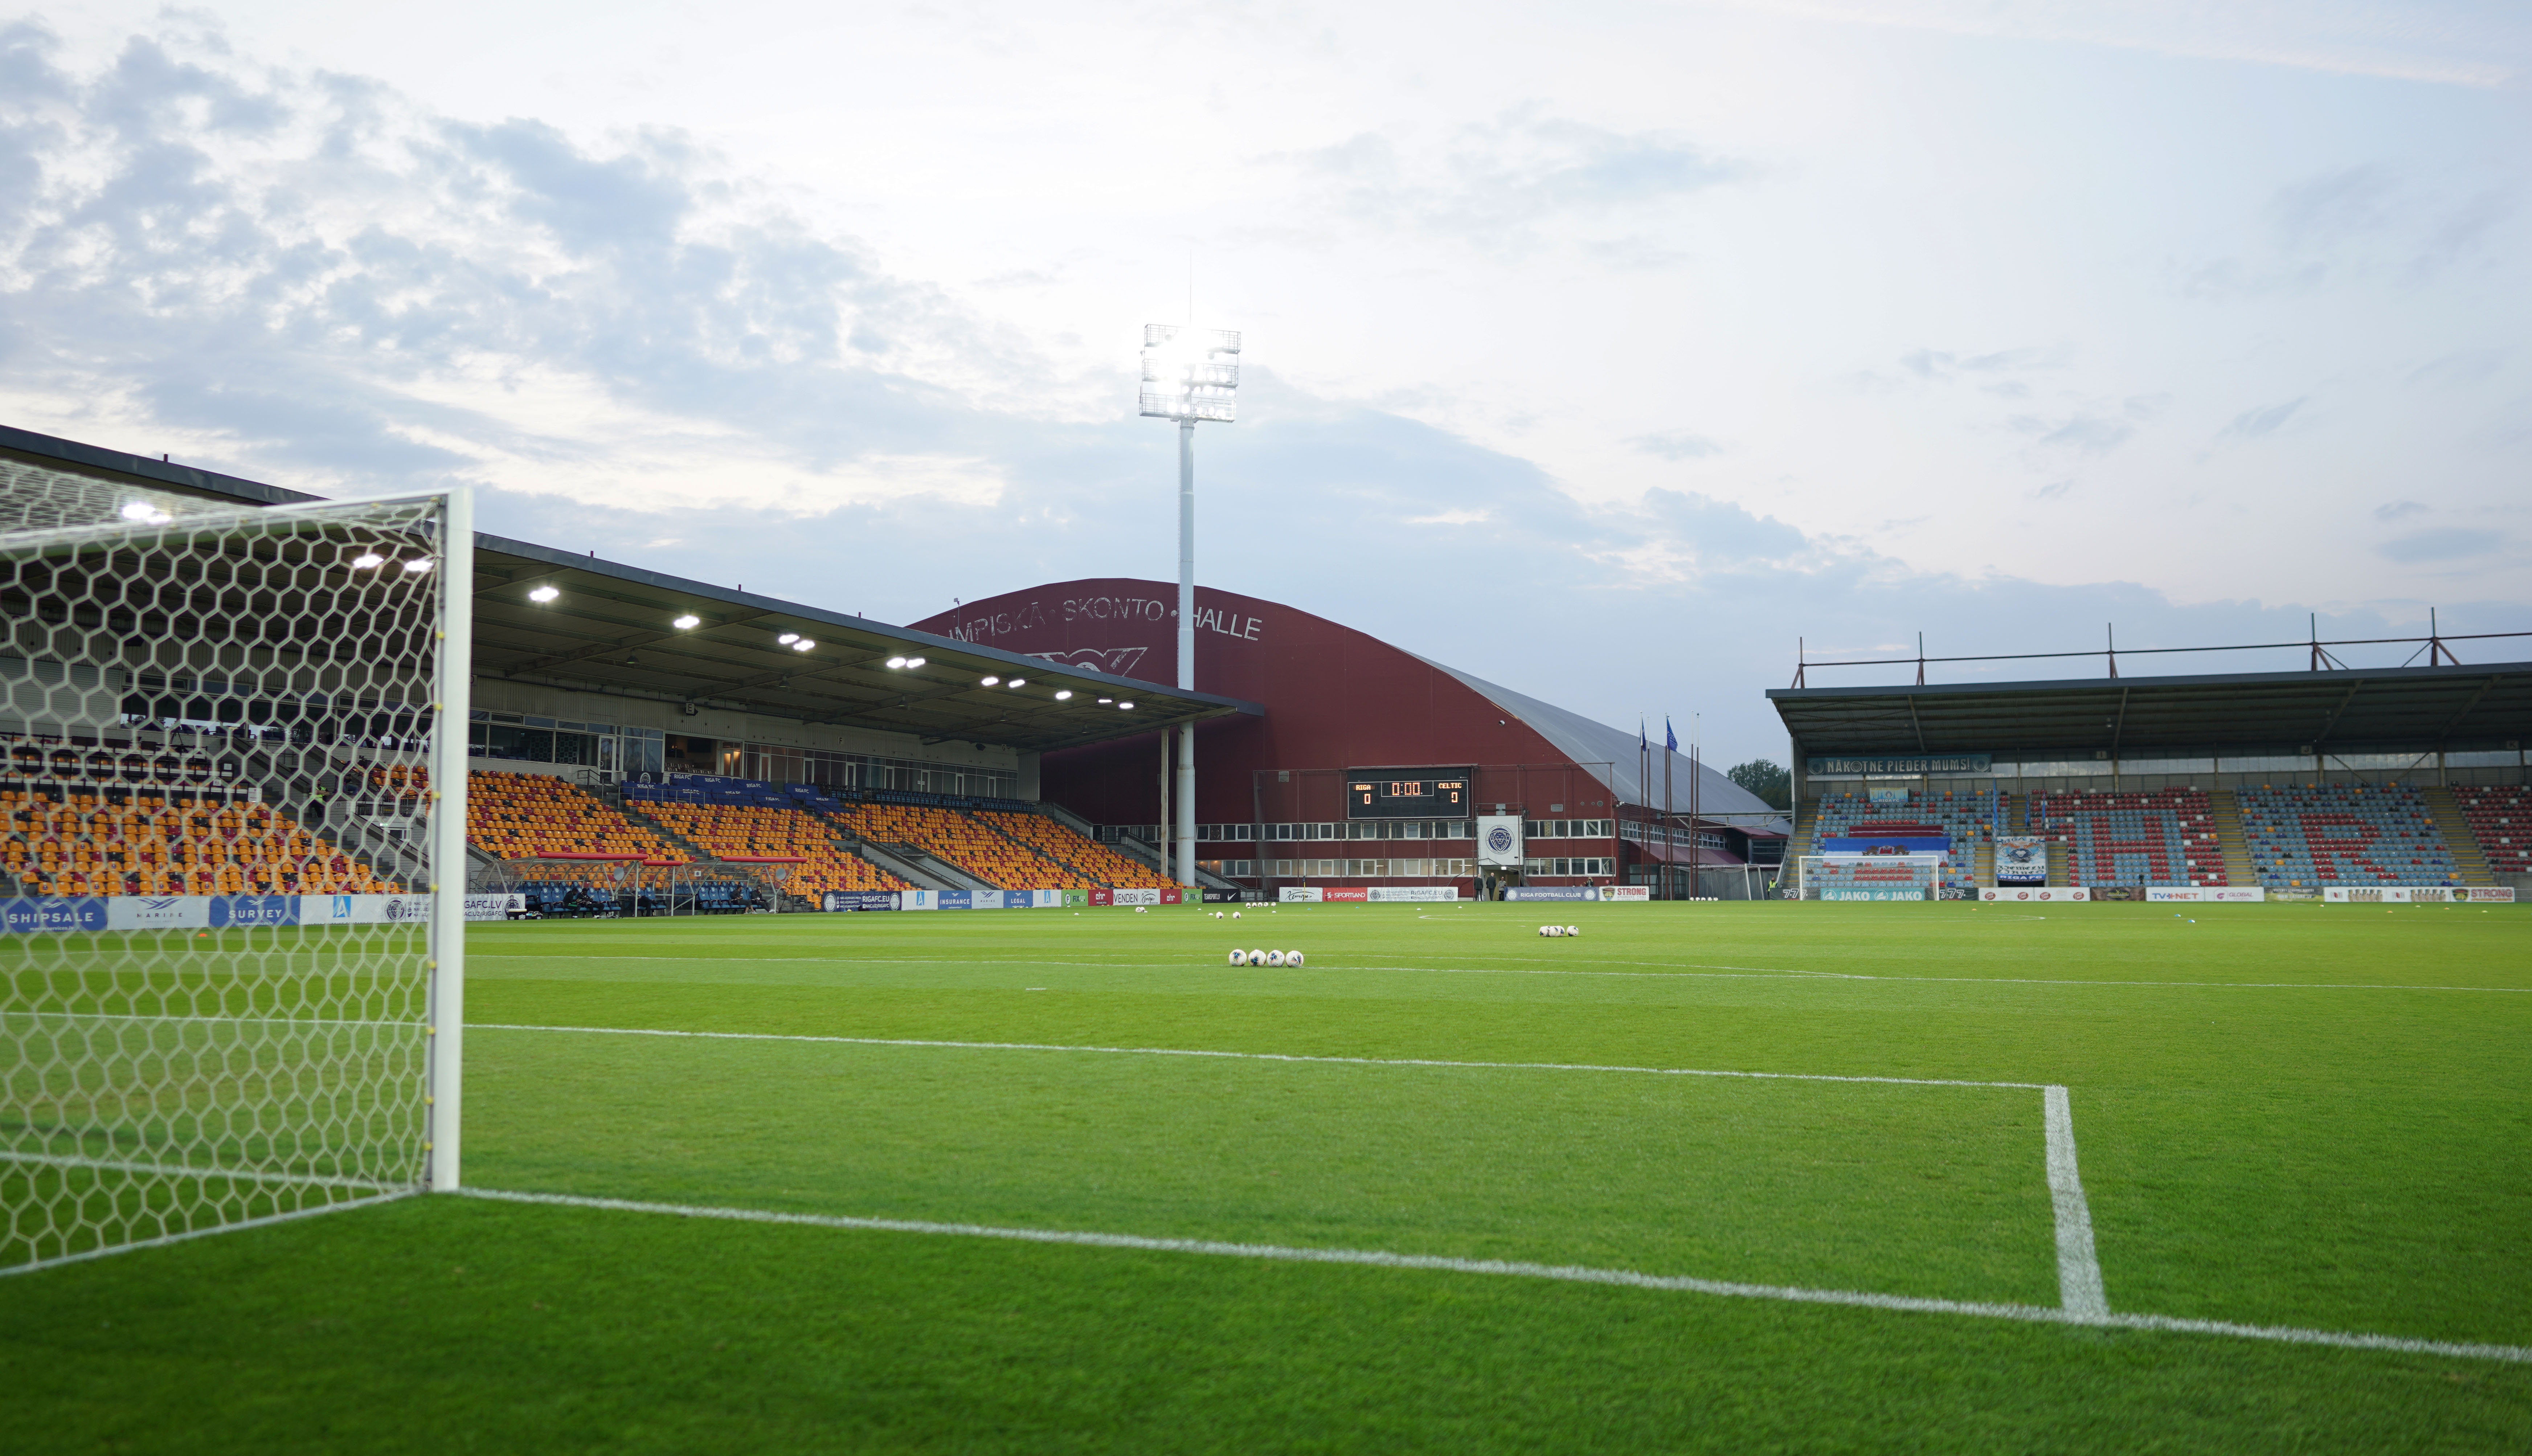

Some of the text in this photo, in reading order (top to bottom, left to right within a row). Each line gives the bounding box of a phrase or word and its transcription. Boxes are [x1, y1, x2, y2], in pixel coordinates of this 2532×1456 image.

[1063, 597, 1164, 621] SKONTO
[1888, 760, 1928, 772] PIEDER
[1932, 757, 1970, 770] MUMS!
[1392, 782, 1420, 796] 0:00
[1364, 794, 1371, 804] 0
[1113, 893, 1138, 903] VENDEN
[1839, 891, 1870, 901] JAKO
[1891, 891, 1922, 901] JAKO
[2471, 889, 2513, 897] STRONG
[9, 913, 94, 923] SHIPSALE
[229, 909, 282, 919] SURVEY
